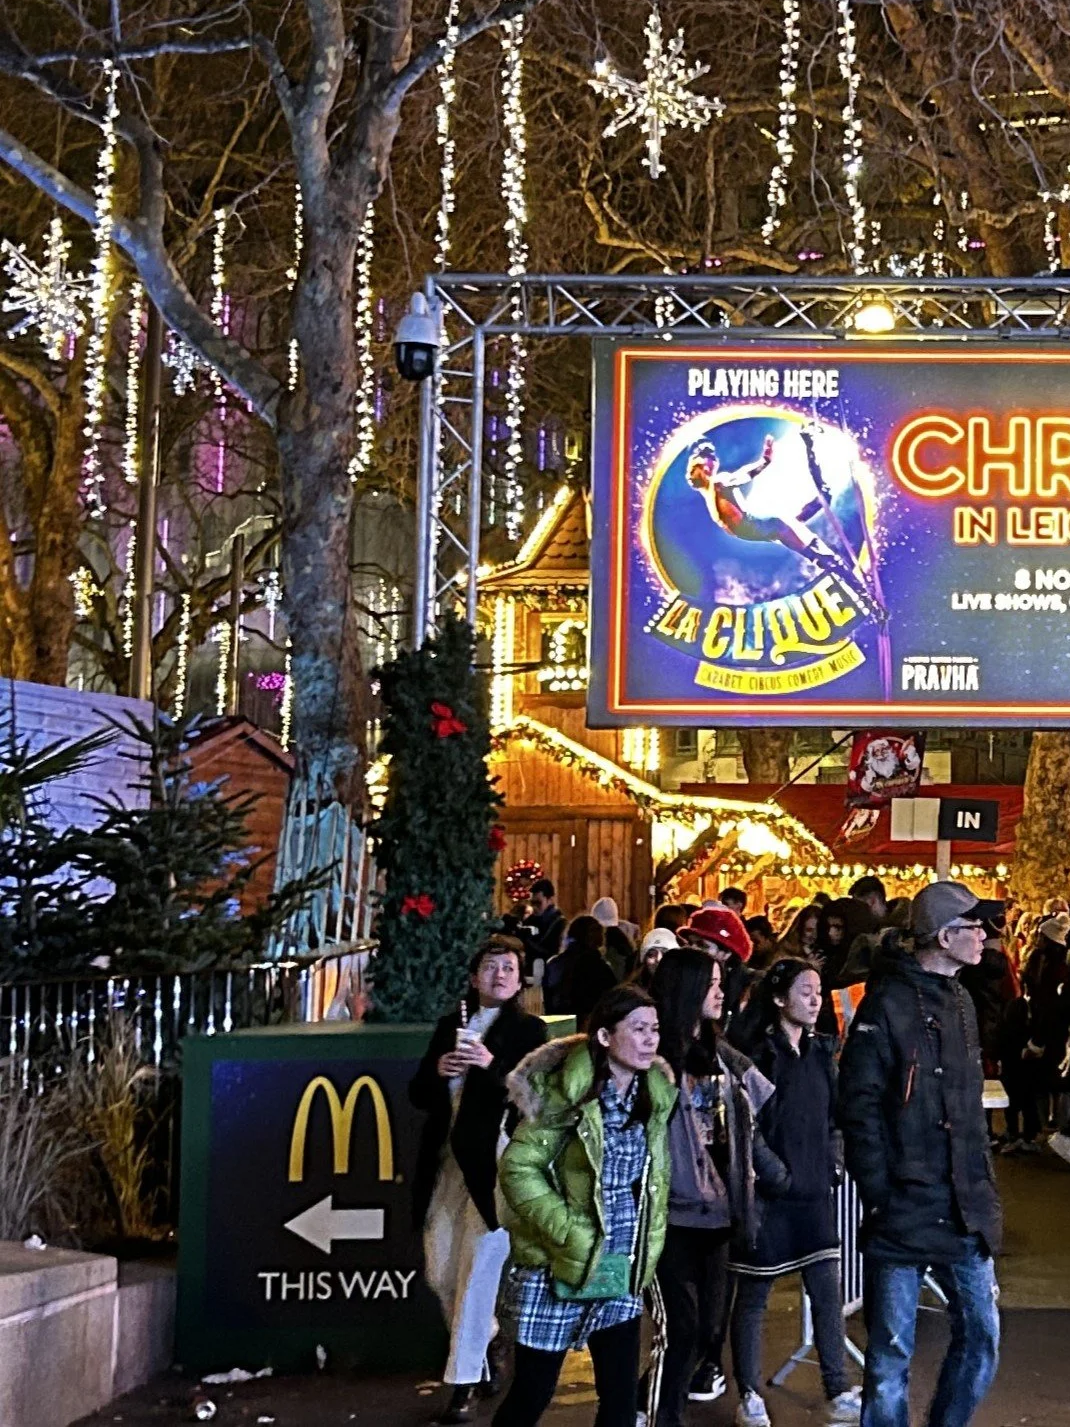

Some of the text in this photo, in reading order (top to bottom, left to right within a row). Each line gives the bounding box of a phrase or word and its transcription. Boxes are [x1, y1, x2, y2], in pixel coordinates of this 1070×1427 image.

[688, 369, 840, 398] PLAYING HERE
[954, 505, 996, 545] IN
[1014, 569, 1031, 590] 8
[951, 592, 992, 610] LIVE
[995, 592, 1067, 613] SHOWS,
[656, 575, 857, 665] LA CLIQUE
[902, 664, 979, 690] PRAVHA
[956, 810, 981, 829] IN
[258, 1270, 417, 1302] THIS WAY
